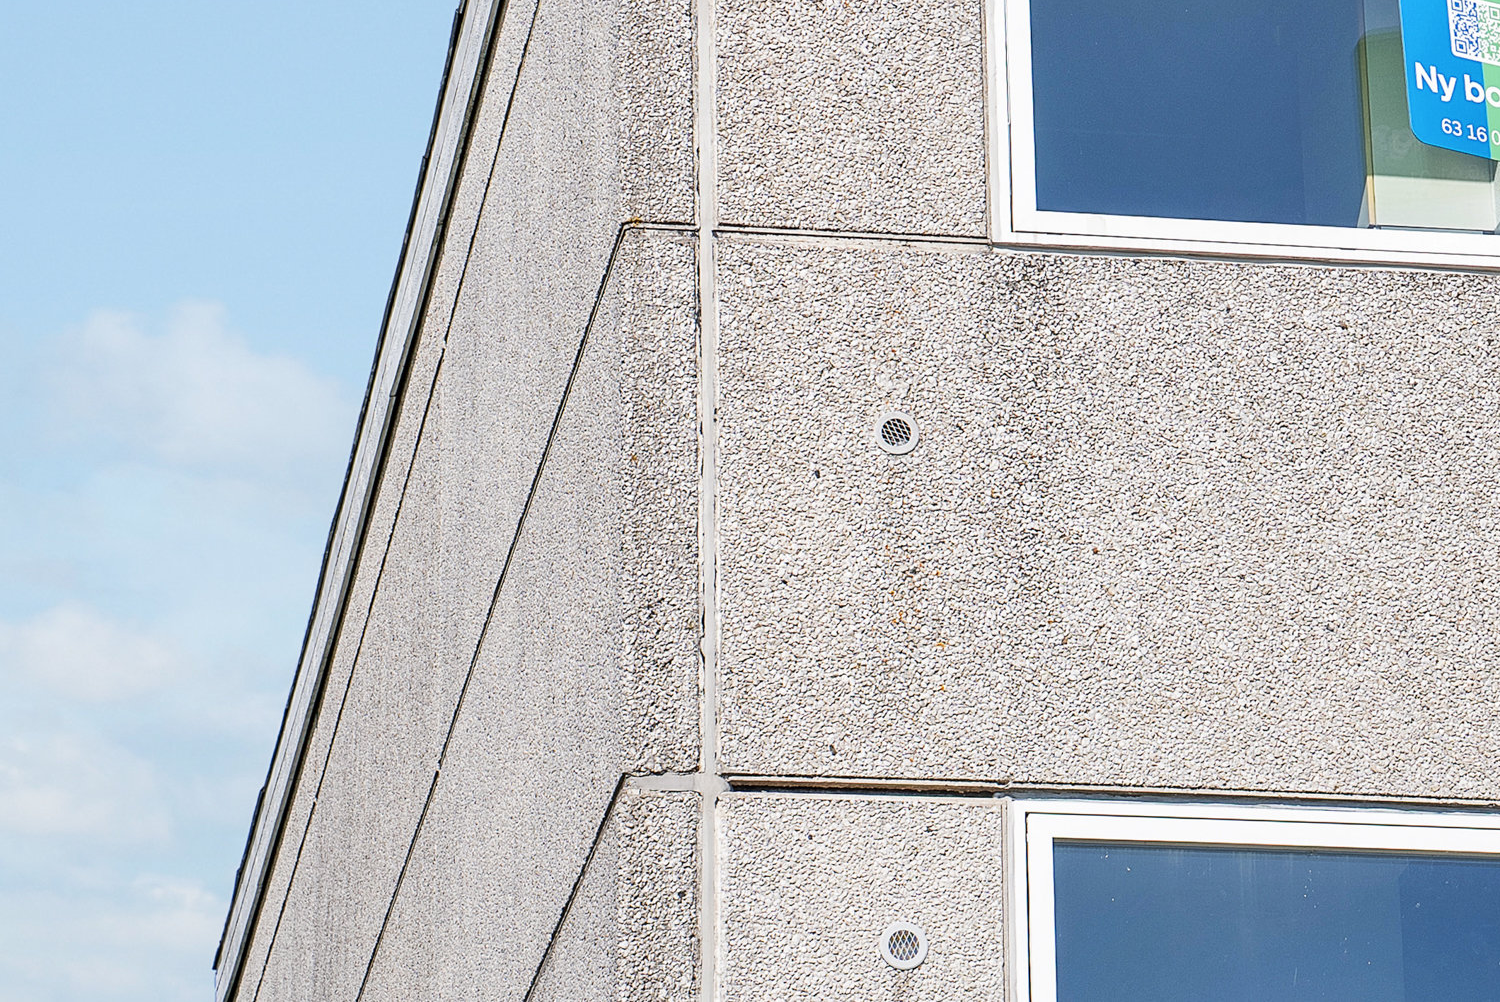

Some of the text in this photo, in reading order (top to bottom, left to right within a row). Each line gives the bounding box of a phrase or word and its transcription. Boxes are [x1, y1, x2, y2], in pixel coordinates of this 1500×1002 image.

[1415, 62, 1457, 102] Ny
[1441, 118, 1462, 135] 63
[1467, 124, 1488, 143] 16
